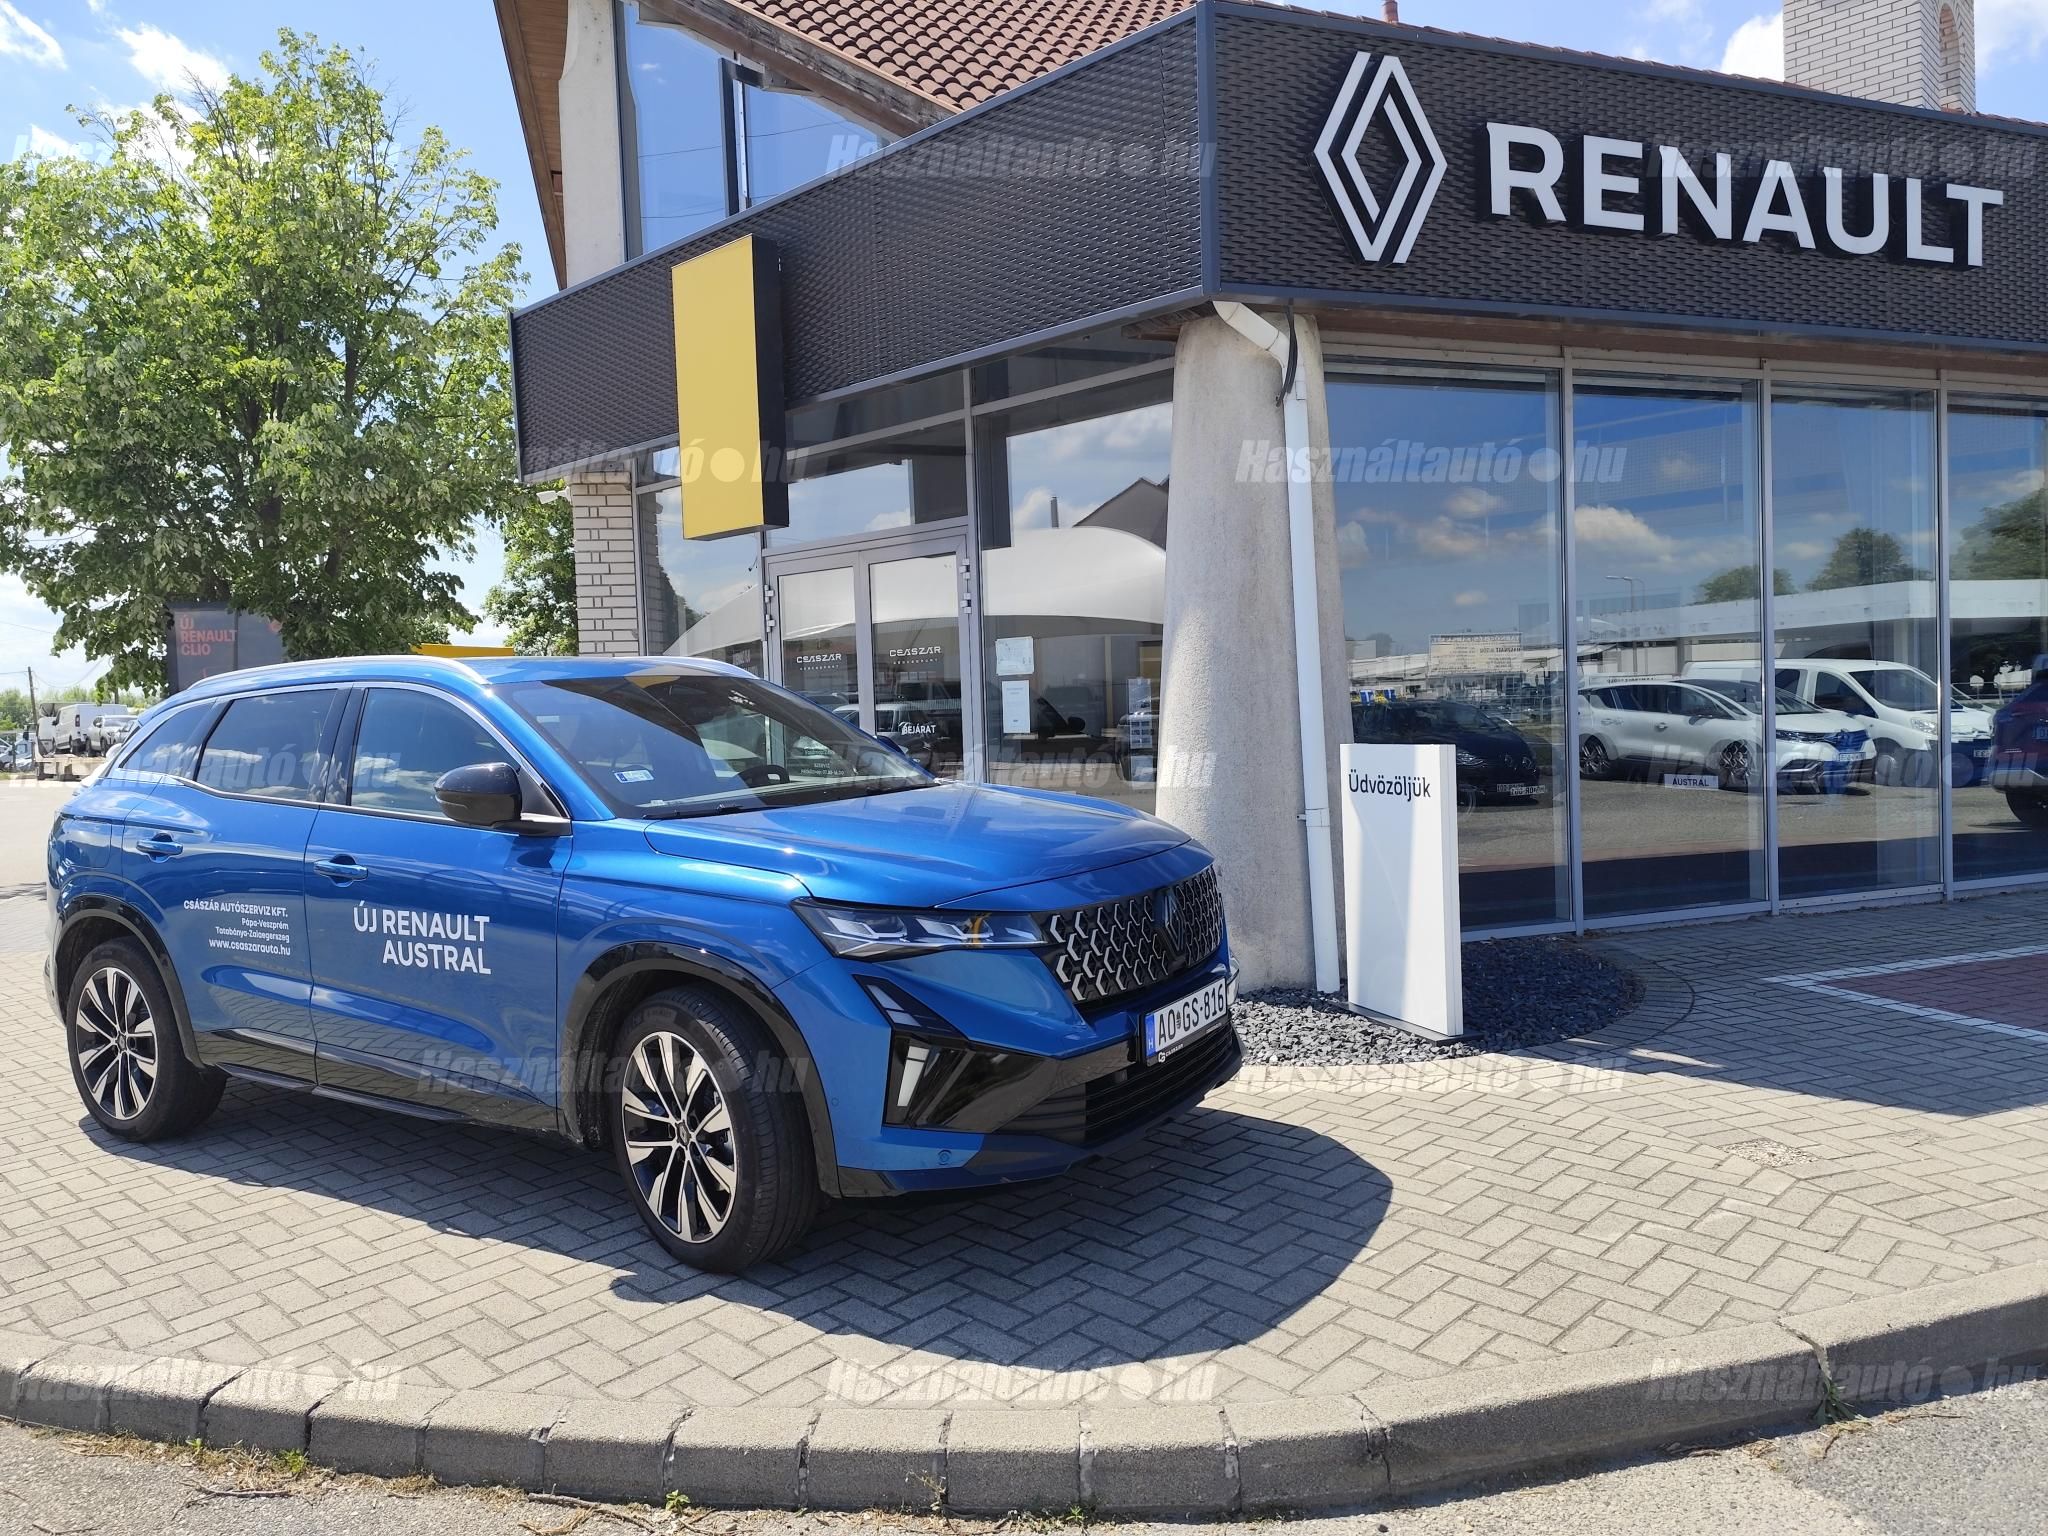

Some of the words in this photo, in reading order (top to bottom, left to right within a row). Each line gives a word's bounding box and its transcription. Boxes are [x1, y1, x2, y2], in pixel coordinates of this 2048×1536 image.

[1485, 121, 2004, 267] RENAULT
[181, 629, 237, 643] RENAULT
[181, 643, 211, 656] CLIO
[1348, 768, 1431, 802] Üdvözöljük
[1672, 778, 1710, 787] AUSTRAL
[183, 898, 220, 911] CSÁSZÁR
[220, 901, 271, 915] AUTÓSZERVIZ
[271, 906, 288, 917] KFT.
[353, 900, 377, 933] ÚJ
[382, 909, 490, 942] RENAULT
[208, 938, 291, 956] www.csaszarauto.hu
[382, 940, 492, 975] AUSTRAL
[1158, 1008, 1176, 1046] AO
